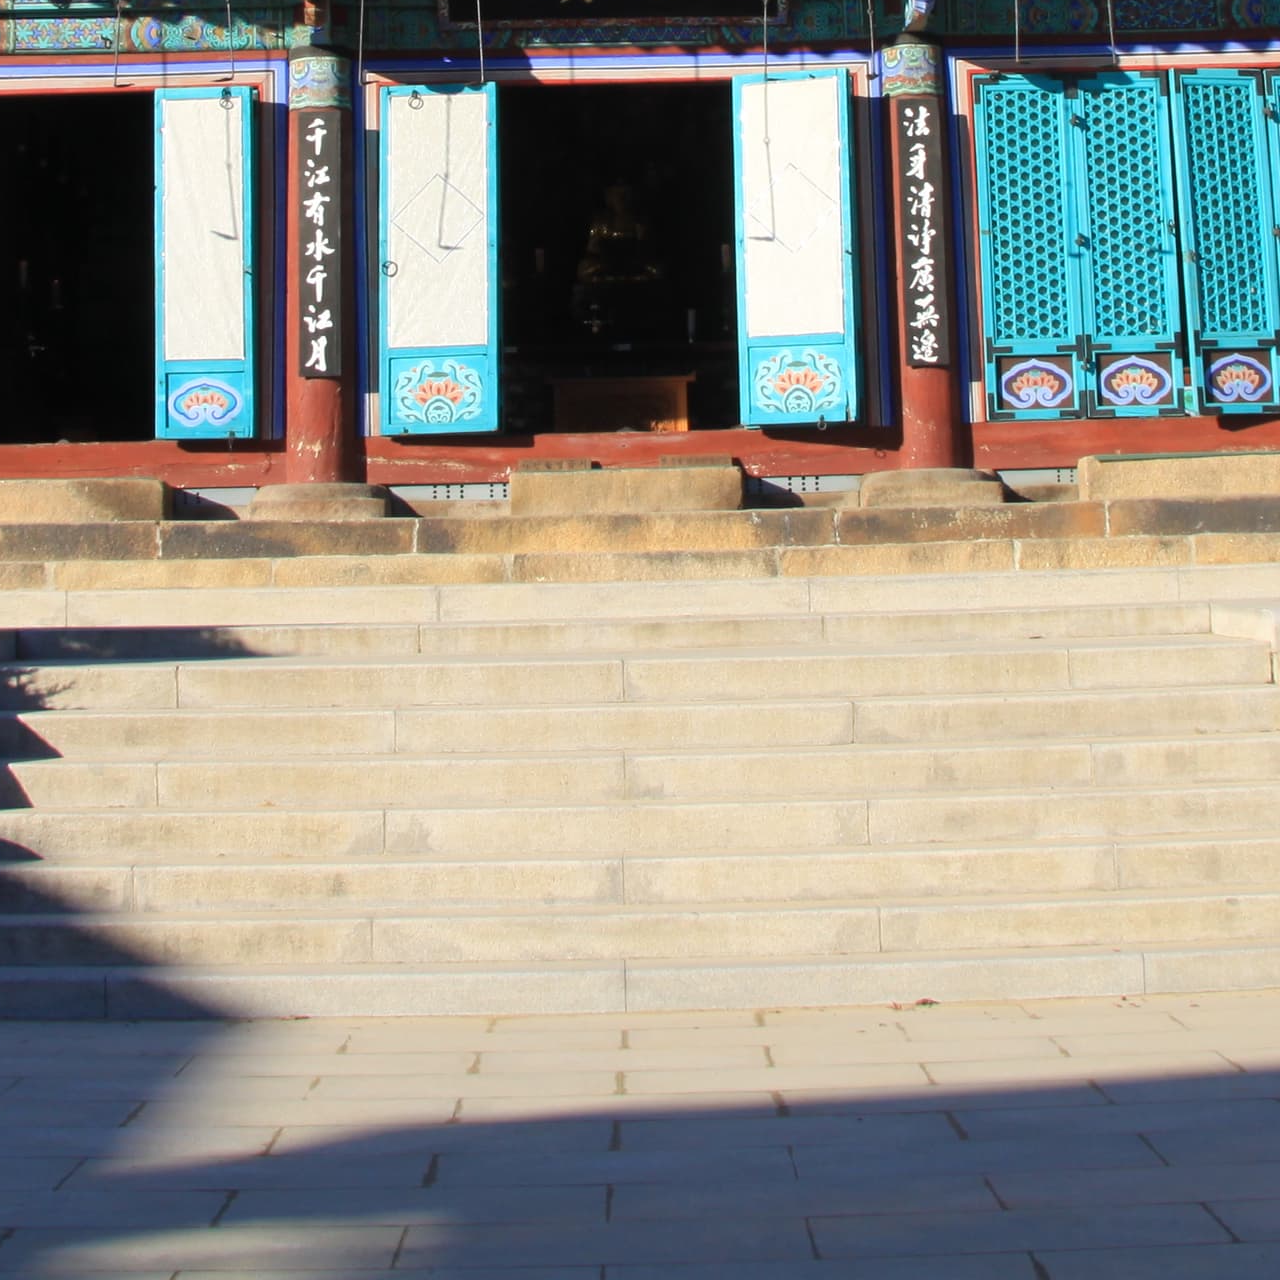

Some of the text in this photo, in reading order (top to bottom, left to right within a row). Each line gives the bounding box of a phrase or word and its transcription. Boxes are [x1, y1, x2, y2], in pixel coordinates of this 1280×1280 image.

[303, 118, 336, 372] 千江有水千江月
